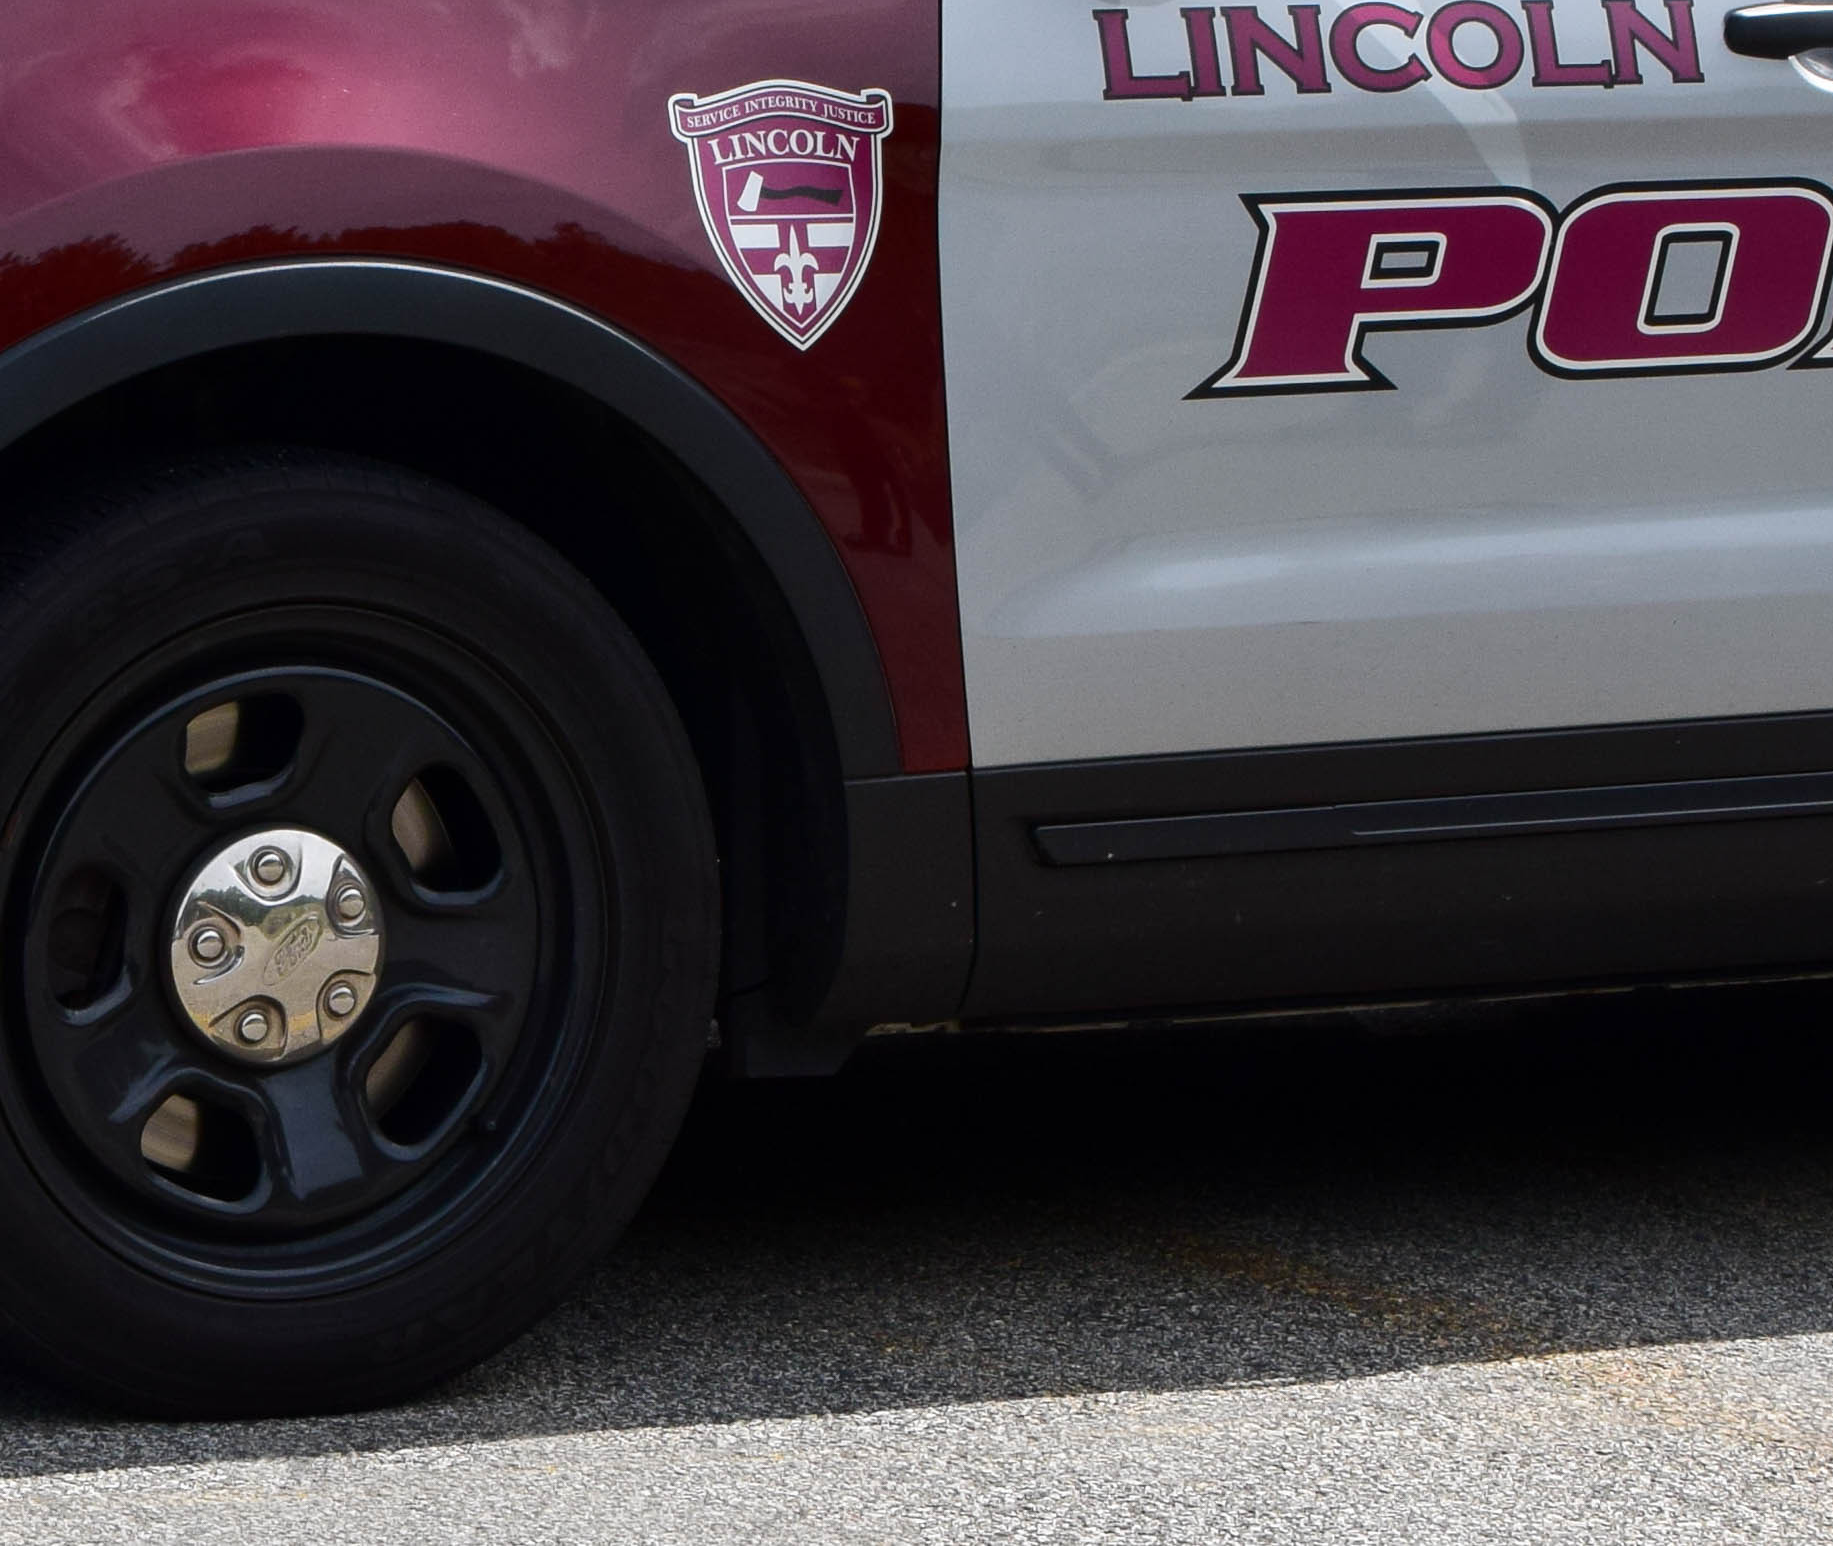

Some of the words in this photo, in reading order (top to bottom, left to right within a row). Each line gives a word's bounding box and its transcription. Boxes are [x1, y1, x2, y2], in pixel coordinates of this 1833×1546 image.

[687, 105, 741, 128] SERVICE
[745, 95, 819, 114] INTEGRITY
[820, 104, 877, 125] JUSTICE
[708, 128, 861, 166] LINCOLN
